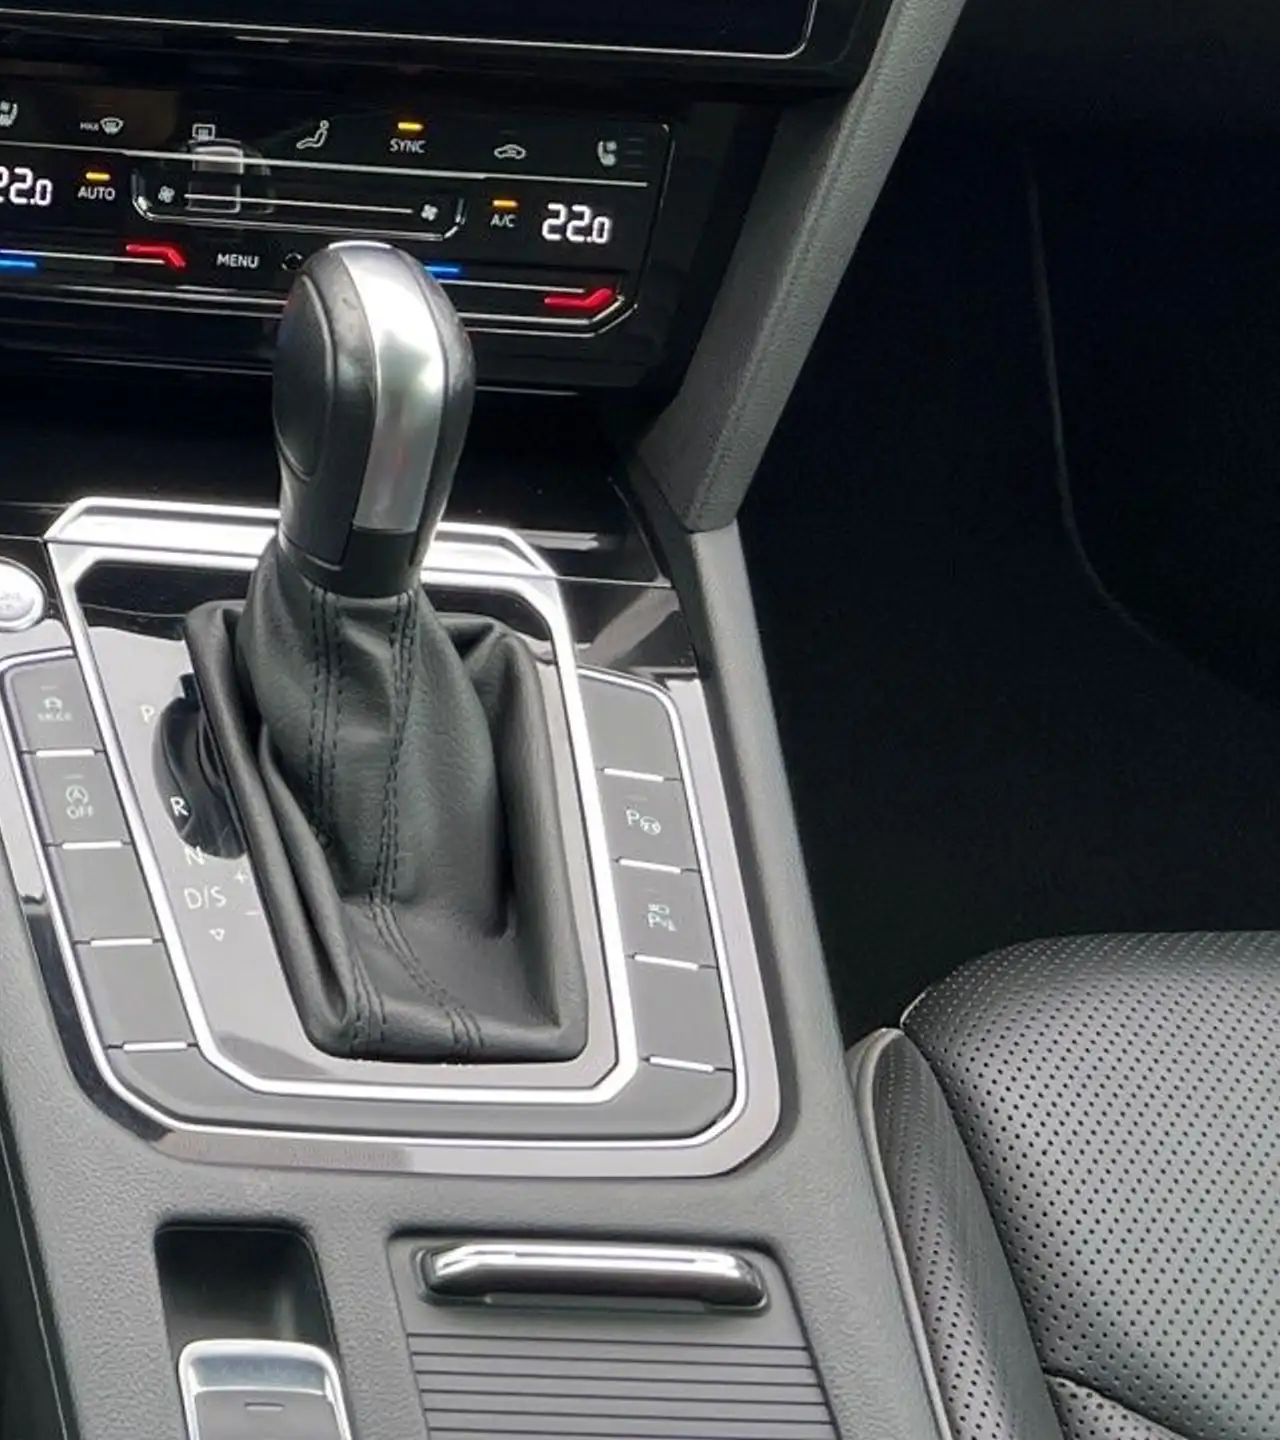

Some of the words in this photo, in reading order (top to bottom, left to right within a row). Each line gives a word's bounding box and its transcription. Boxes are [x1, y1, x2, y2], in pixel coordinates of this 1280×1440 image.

[390, 138, 427, 154] SYNC
[77, 185, 117, 201] AUTO
[490, 213, 517, 228] A/C
[542, 202, 613, 244] 22.0
[216, 252, 260, 269] MENU
[140, 704, 155, 723] P
[66, 804, 95, 820] OFF
[169, 796, 189, 816] R
[184, 844, 206, 866] N
[183, 885, 228, 910] D/S
